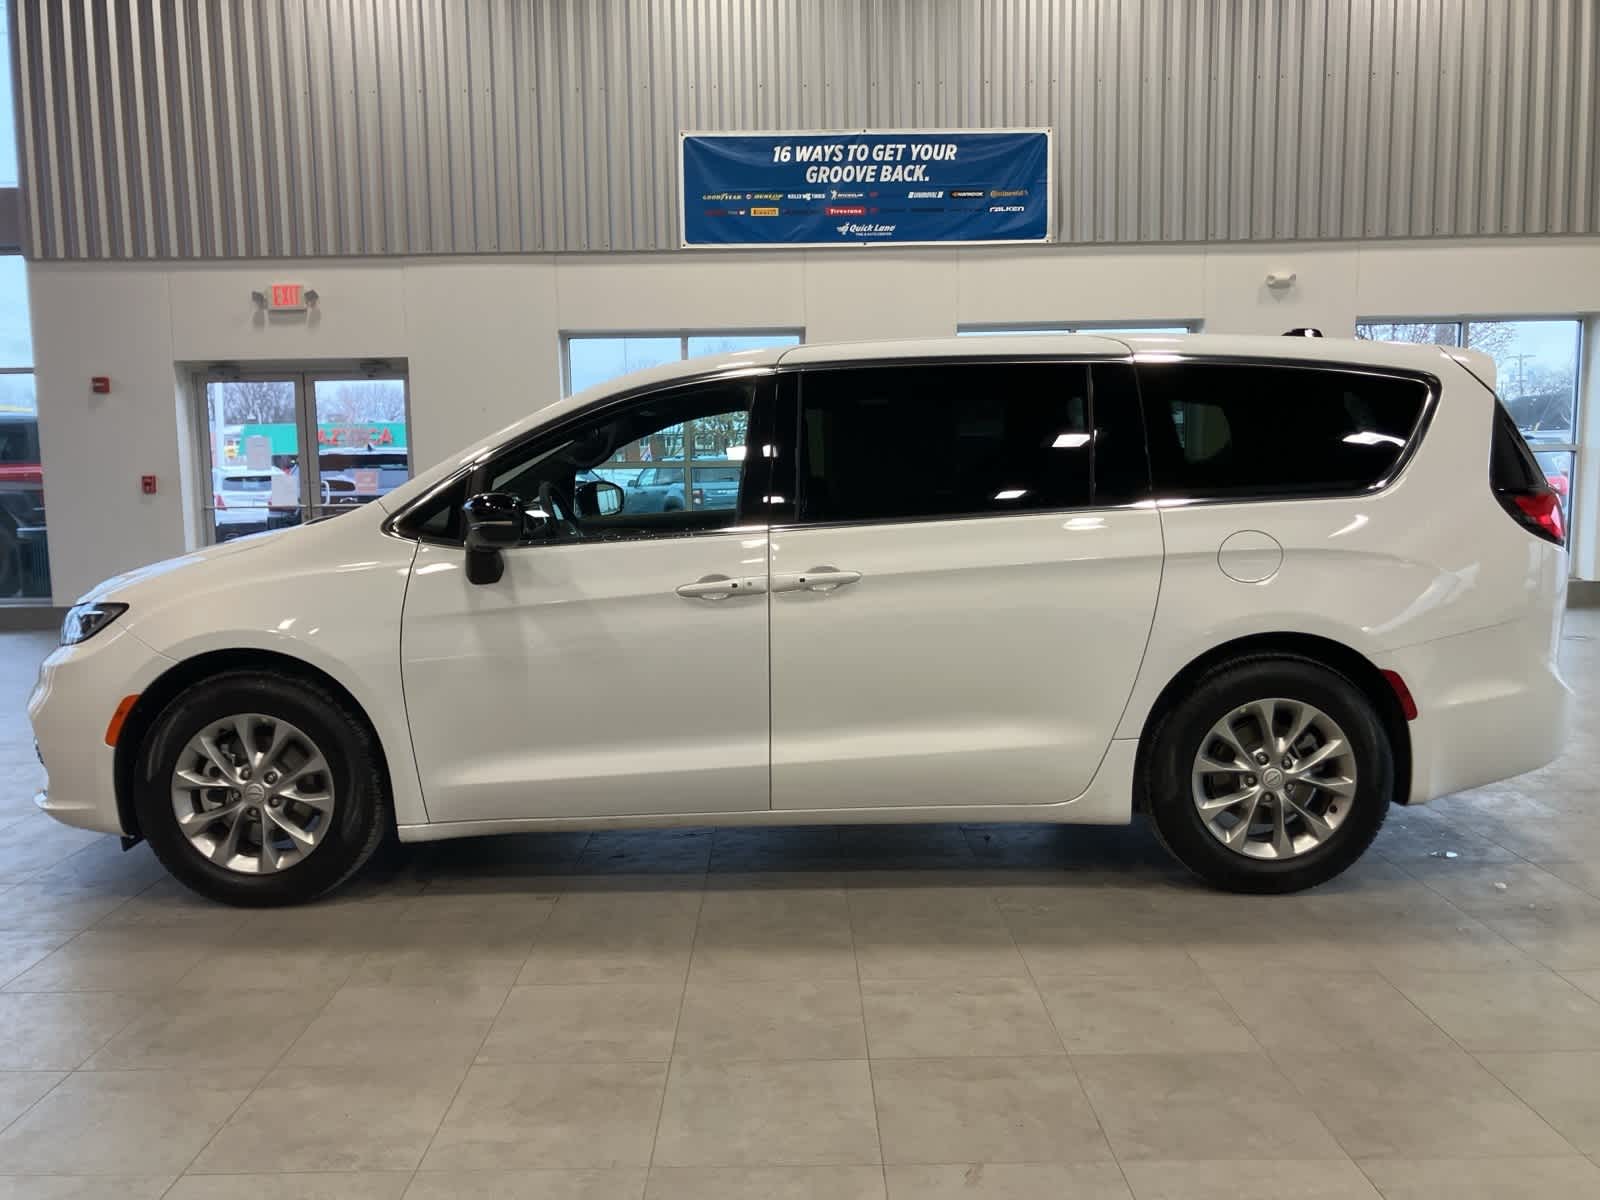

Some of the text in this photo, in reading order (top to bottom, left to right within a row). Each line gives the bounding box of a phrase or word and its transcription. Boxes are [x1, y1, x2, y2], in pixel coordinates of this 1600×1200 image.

[773, 144, 957, 162] 16 WAYS TO GET YOUR
[805, 164, 930, 183] GROOVE BACK.
[850, 224, 896, 233] Quick Lane
[272, 286, 301, 306] EXIT
